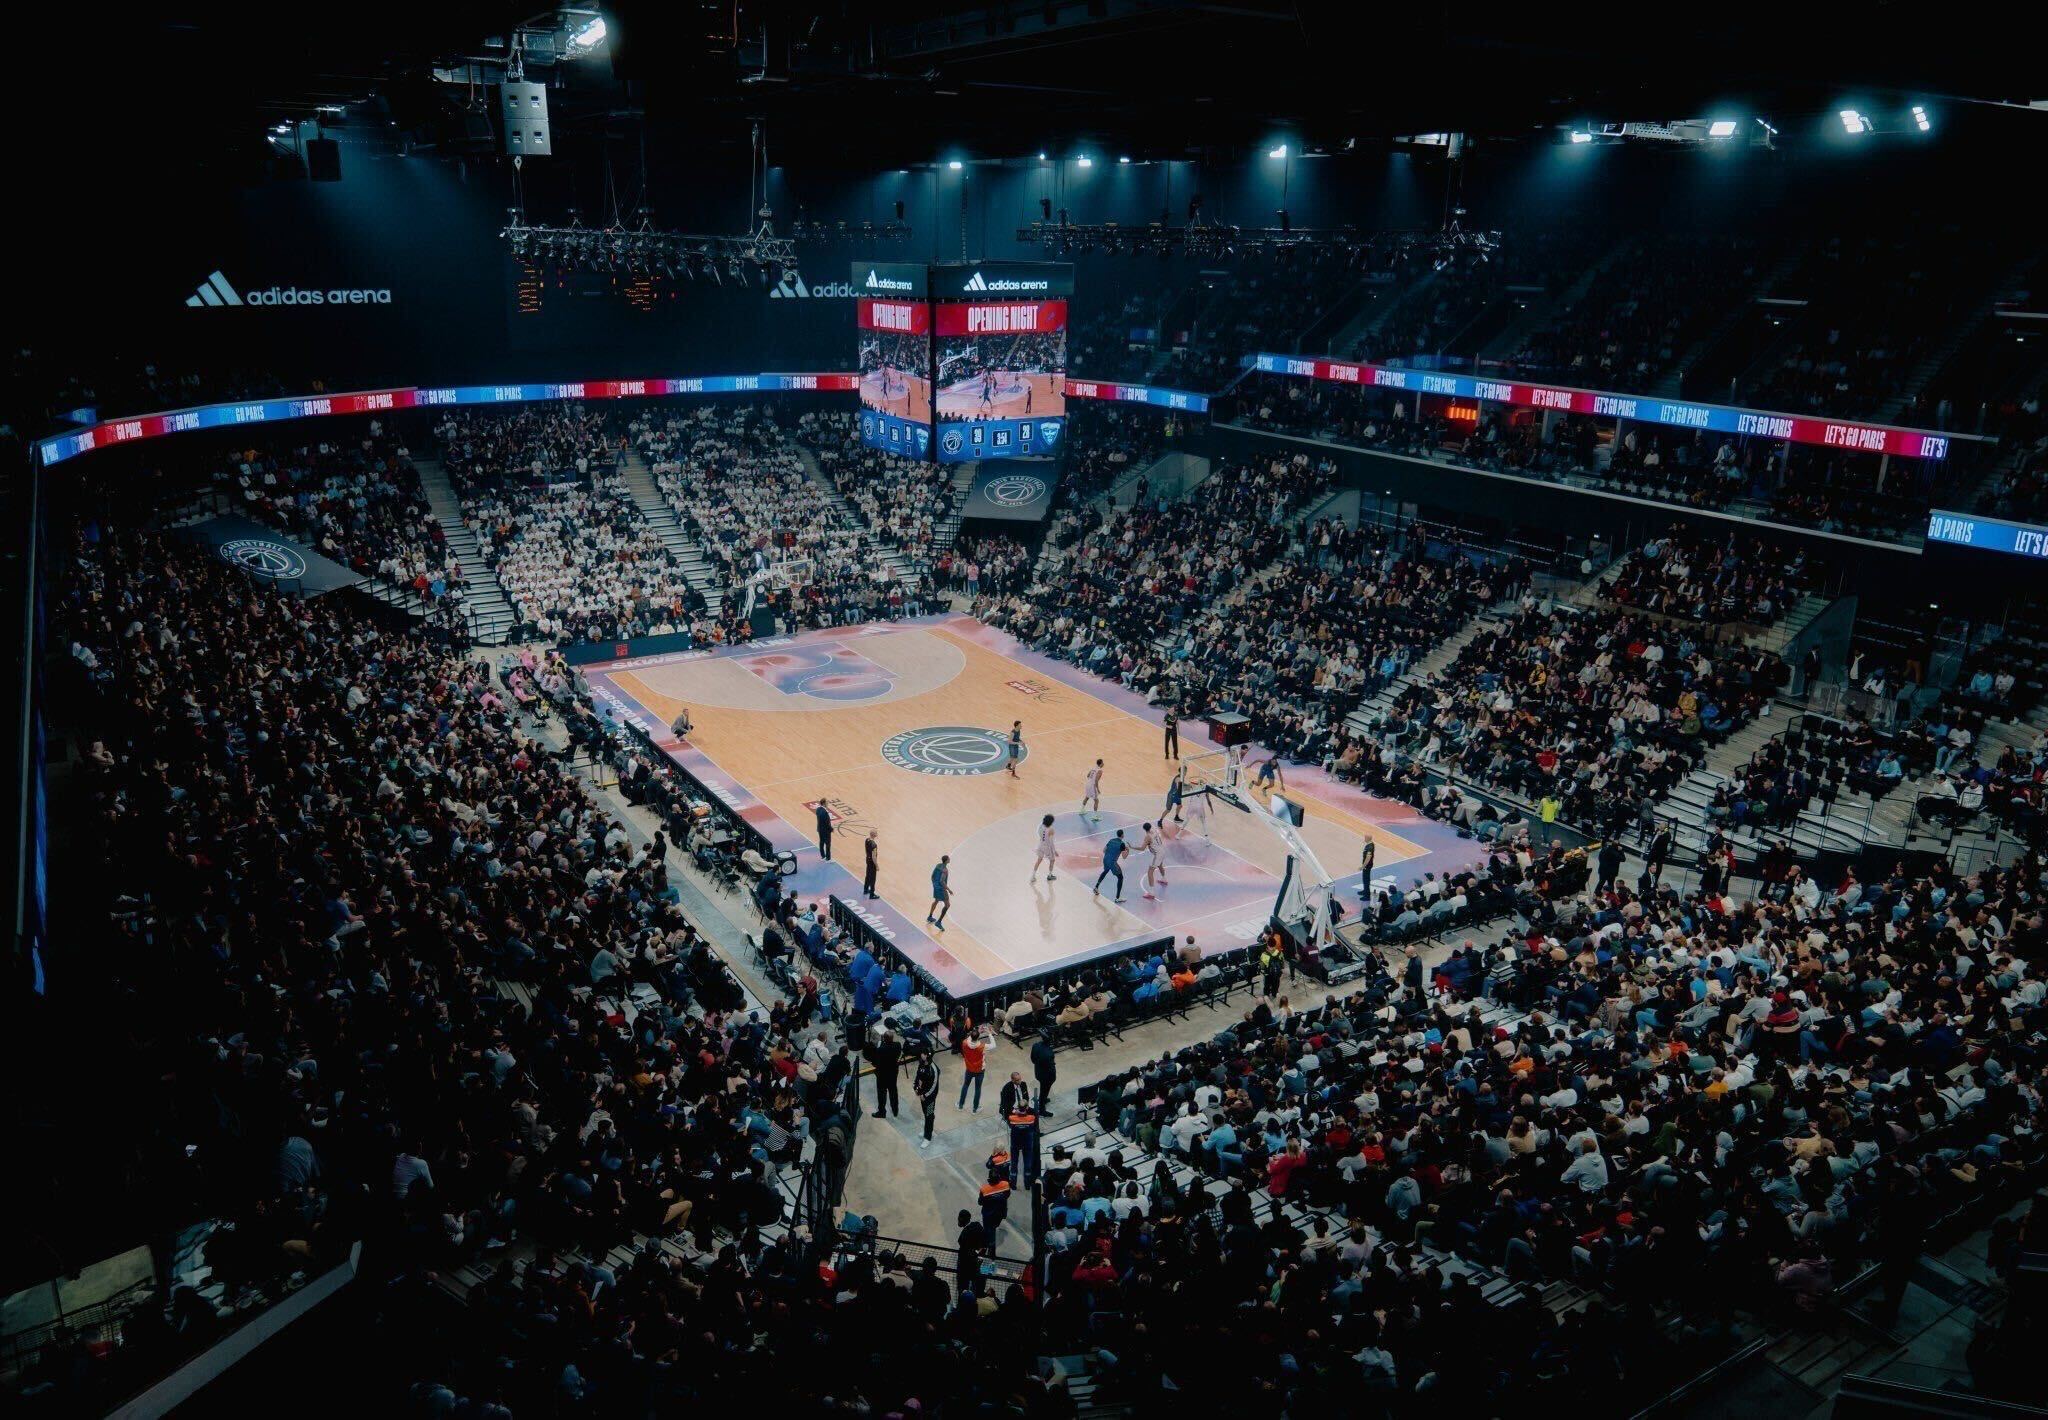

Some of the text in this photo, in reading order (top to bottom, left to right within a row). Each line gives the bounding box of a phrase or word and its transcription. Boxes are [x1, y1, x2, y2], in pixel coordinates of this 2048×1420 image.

[813, 282, 868, 298] adida
[879, 278, 912, 291] adidas arena
[988, 280, 1048, 291] adidas arena
[247, 287, 392, 306] adidas arena
[968, 305, 1039, 332] OPENING NIGHT
[559, 384, 568, 398] GO
[568, 383, 584, 398] PARIS
[620, 382, 629, 396] GO
[629, 380, 646, 396] PARIS
[679, 378, 688, 393] GO
[687, 378, 703, 393] PARIS
[793, 376, 802, 390] GO
[801, 375, 818, 390] PARIS
[1475, 381, 1512, 402] LET'S GO PARIS
[368, 394, 377, 410] GO
[376, 392, 394, 409] PARIS
[428, 390, 438, 405] GO
[438, 389, 456, 404] PARIS
[495, 387, 505, 401] GO
[504, 386, 522, 401] PARIS
[1532, 388, 1572, 410] LET'S GO PARIS
[235, 408, 245, 423] GO
[245, 405, 264, 421] PARIS
[304, 401, 313, 416] GO
[313, 398, 331, 415] PARIS
[1593, 396, 1637, 418] LET'S GO PARIS
[1660, 404, 1710, 427] LET'S GO PARIS
[116, 424, 125, 441] GO
[125, 420, 142, 440] PARIS
[175, 413, 184, 431] GO
[184, 411, 200, 429] PARIS
[1737, 413, 1793, 439] LET'S GO PARIS
[1824, 424, 1886, 451] LET'S GO PARIS
[1920, 436, 1945, 459] LET'S
[1928, 516, 1974, 543] GO PARIS
[2015, 530, 2042, 555] LET'S
[883, 730, 982, 776] PARIS BASKETBALL
